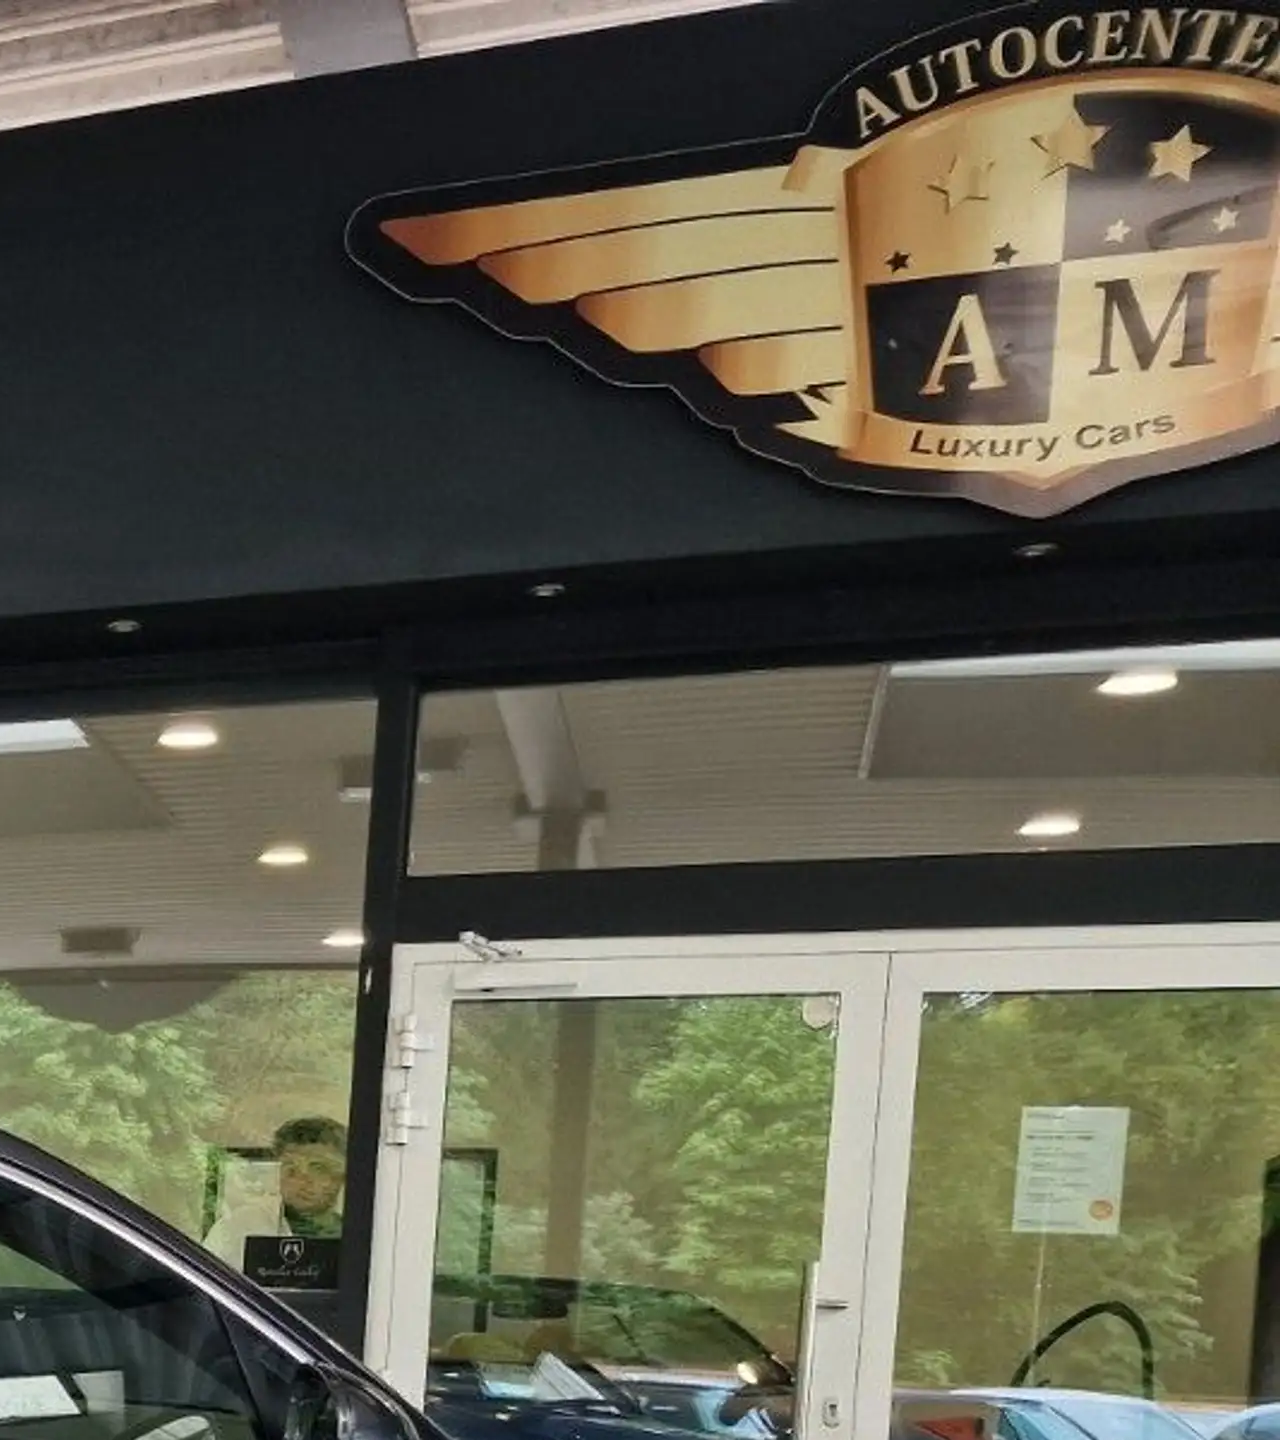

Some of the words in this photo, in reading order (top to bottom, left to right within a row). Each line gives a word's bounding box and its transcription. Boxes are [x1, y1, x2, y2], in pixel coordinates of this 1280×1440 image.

[855, 8, 1280, 139] AUTOCENTE
[918, 293, 1007, 396] A
[1088, 269, 1220, 376] M
[909, 428, 1060, 461] Luxury
[1075, 413, 1176, 450] Cars
